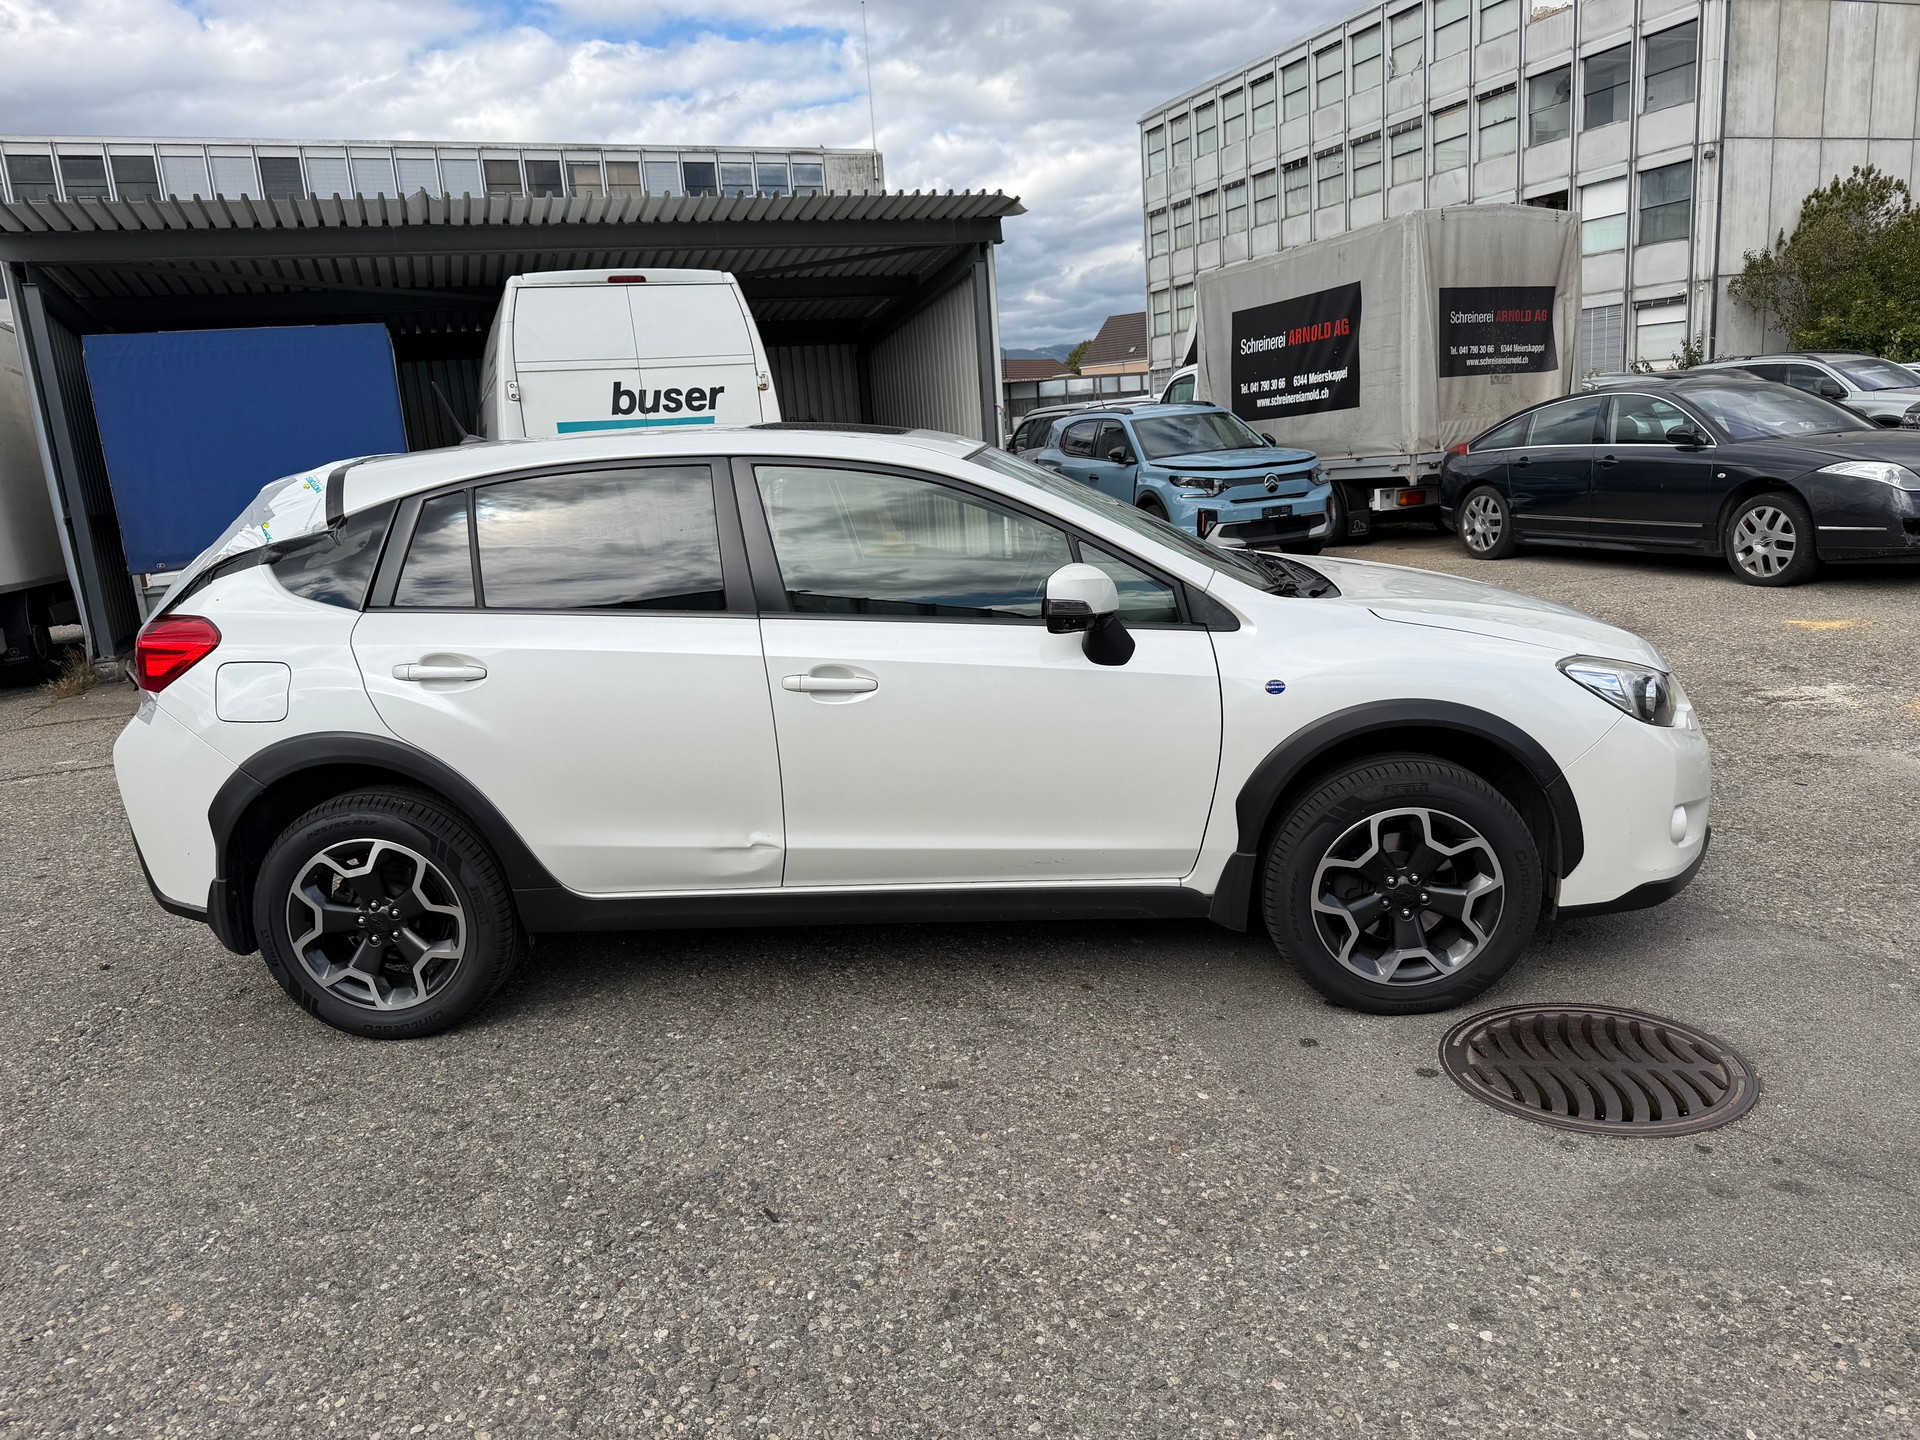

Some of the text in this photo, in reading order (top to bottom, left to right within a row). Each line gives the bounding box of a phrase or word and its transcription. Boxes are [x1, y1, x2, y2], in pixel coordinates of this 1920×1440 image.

[1450, 309, 1547, 324] Schreinerei ARNOLD AG
[1240, 318, 1350, 355] Schreinerei ARNOLD AG
[1450, 344, 1495, 355] Tel. 041 790 30 66
[1500, 344, 1513, 353] 6344
[1293, 366, 1348, 387] 6344 Meierskappel
[1240, 378, 1286, 394] Tel. 041 790 30 66
[611, 381, 724, 416] buser
[1256, 387, 1329, 408] www.schreinereiarnold.ch
